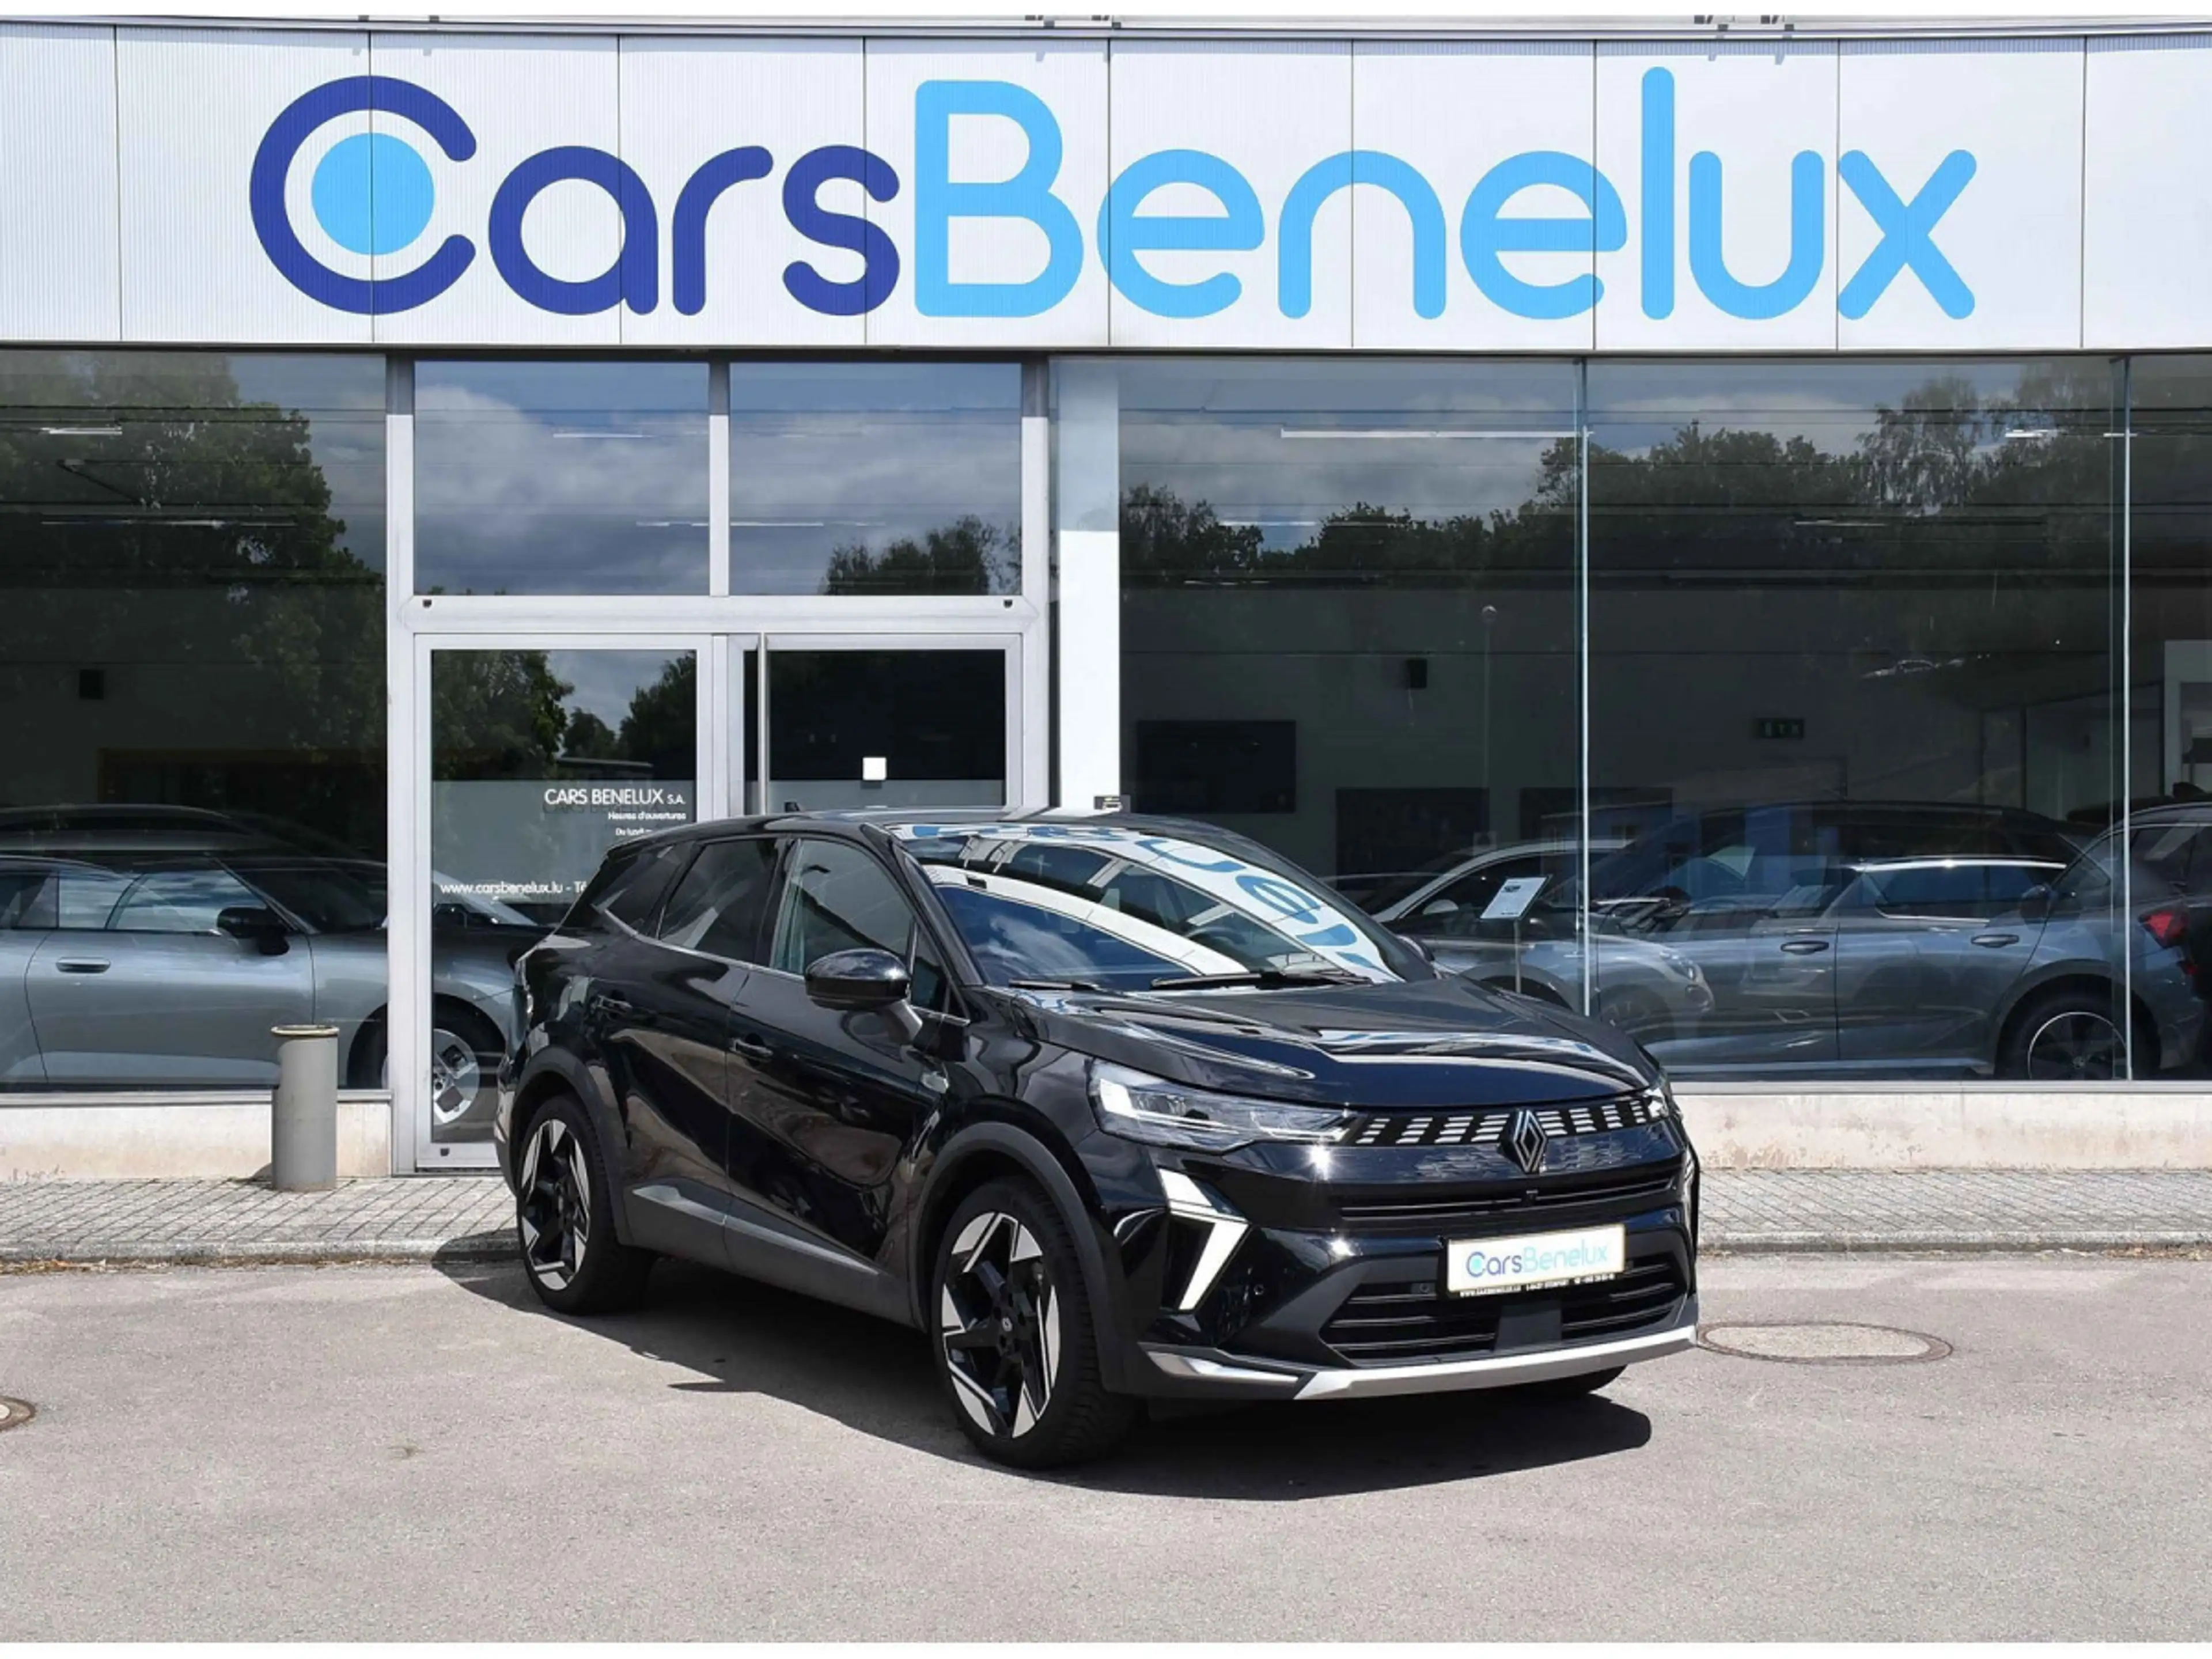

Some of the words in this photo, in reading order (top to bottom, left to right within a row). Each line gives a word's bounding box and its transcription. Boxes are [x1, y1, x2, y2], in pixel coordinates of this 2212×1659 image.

[250, 67, 1977, 319] CarsBenelux
[544, 789, 588, 805] CARS
[592, 789, 664, 805] BENELUX
[440, 881, 563, 893] www.carsbenelux.lu
[1467, 1239, 1608, 1278] CarsBenelux
